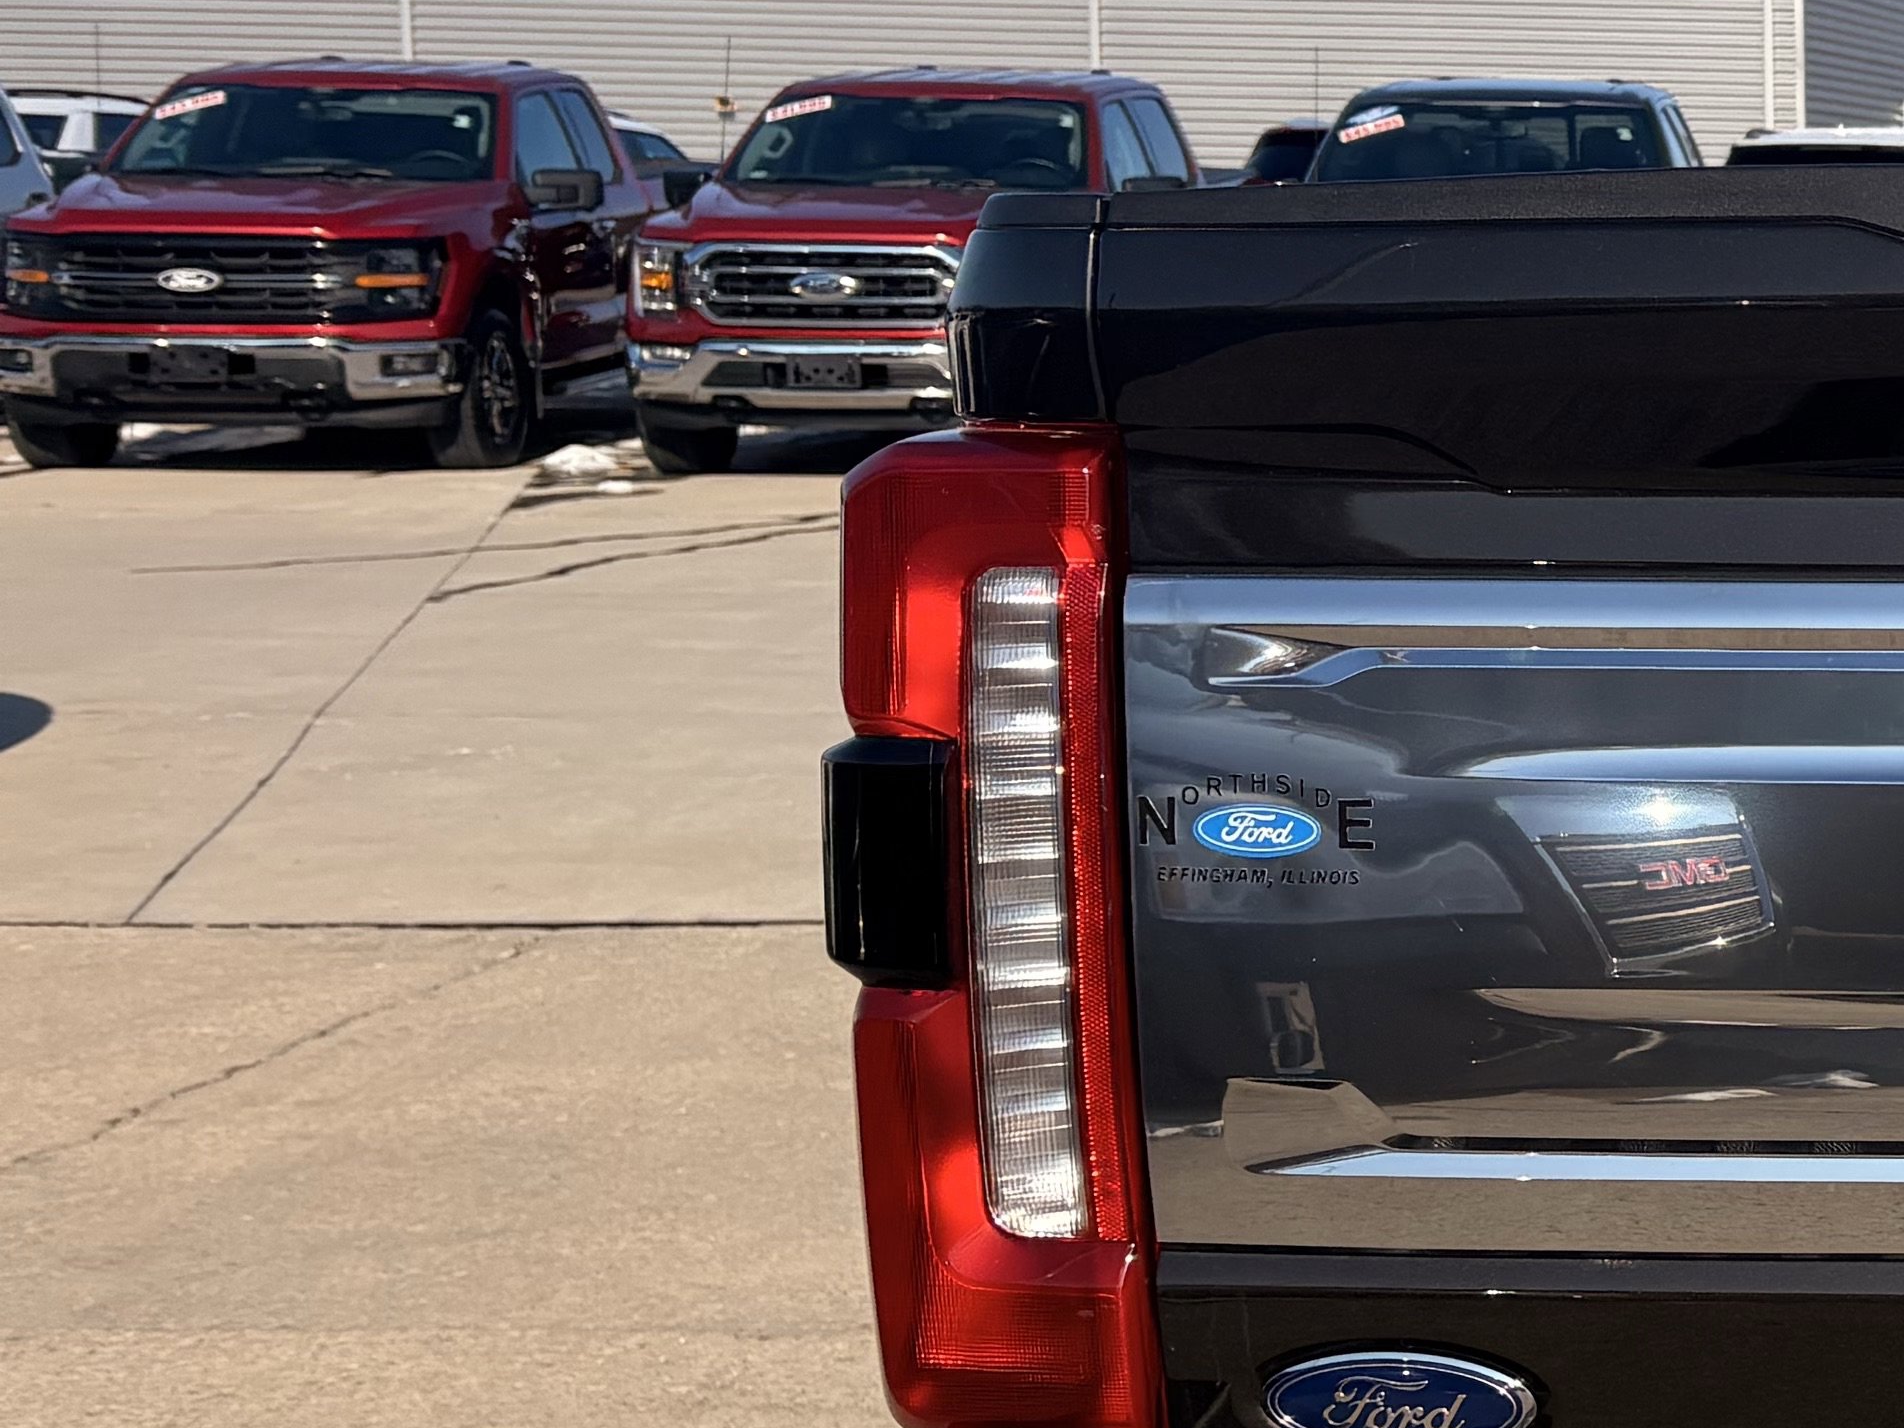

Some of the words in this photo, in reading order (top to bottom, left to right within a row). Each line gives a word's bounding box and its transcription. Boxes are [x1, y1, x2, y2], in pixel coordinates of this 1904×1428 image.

[1220, 811, 1296, 845] Ford
[1157, 866, 1273, 889] EFFINGHAM,
[1280, 870, 1361, 885] ILLINOIS
